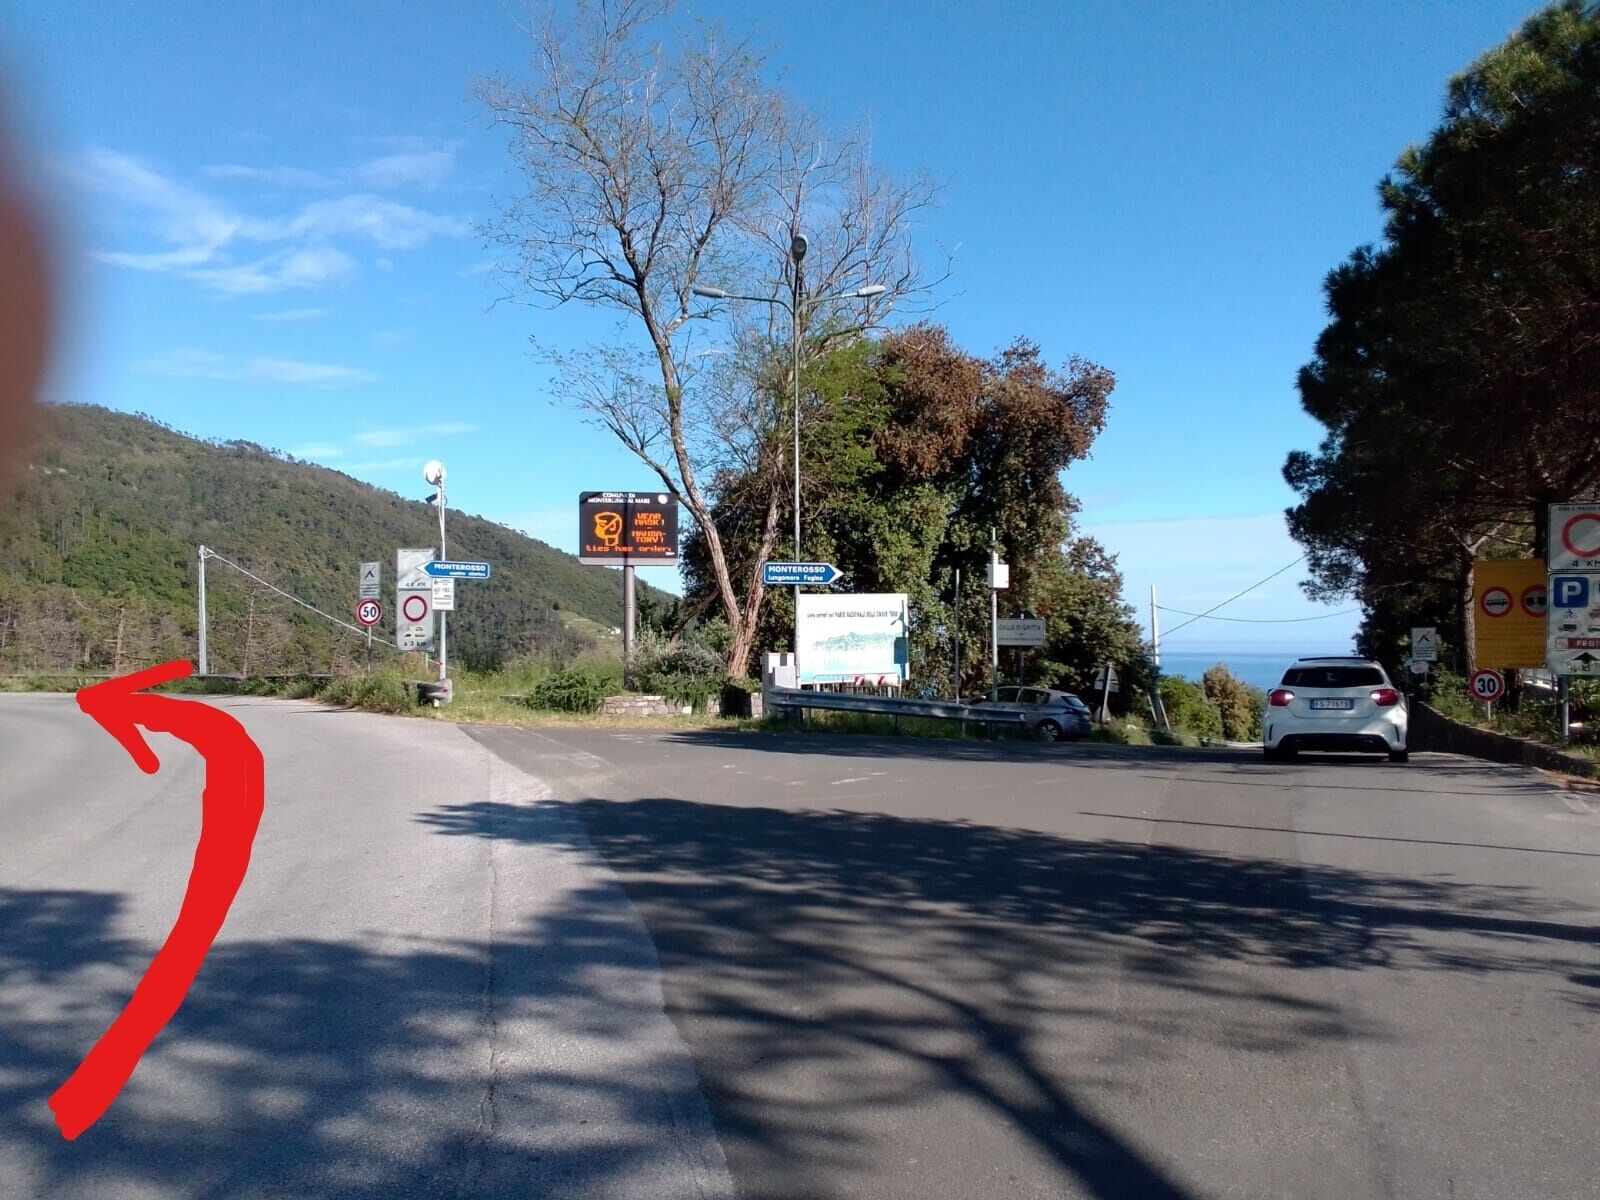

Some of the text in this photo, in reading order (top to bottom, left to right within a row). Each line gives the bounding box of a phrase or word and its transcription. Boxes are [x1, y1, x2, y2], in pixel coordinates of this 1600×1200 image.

[434, 564, 486, 572] MONTEROSSO
[1562, 581, 1582, 604] P
[363, 606, 377, 618] 50
[1477, 678, 1497, 694] 30
